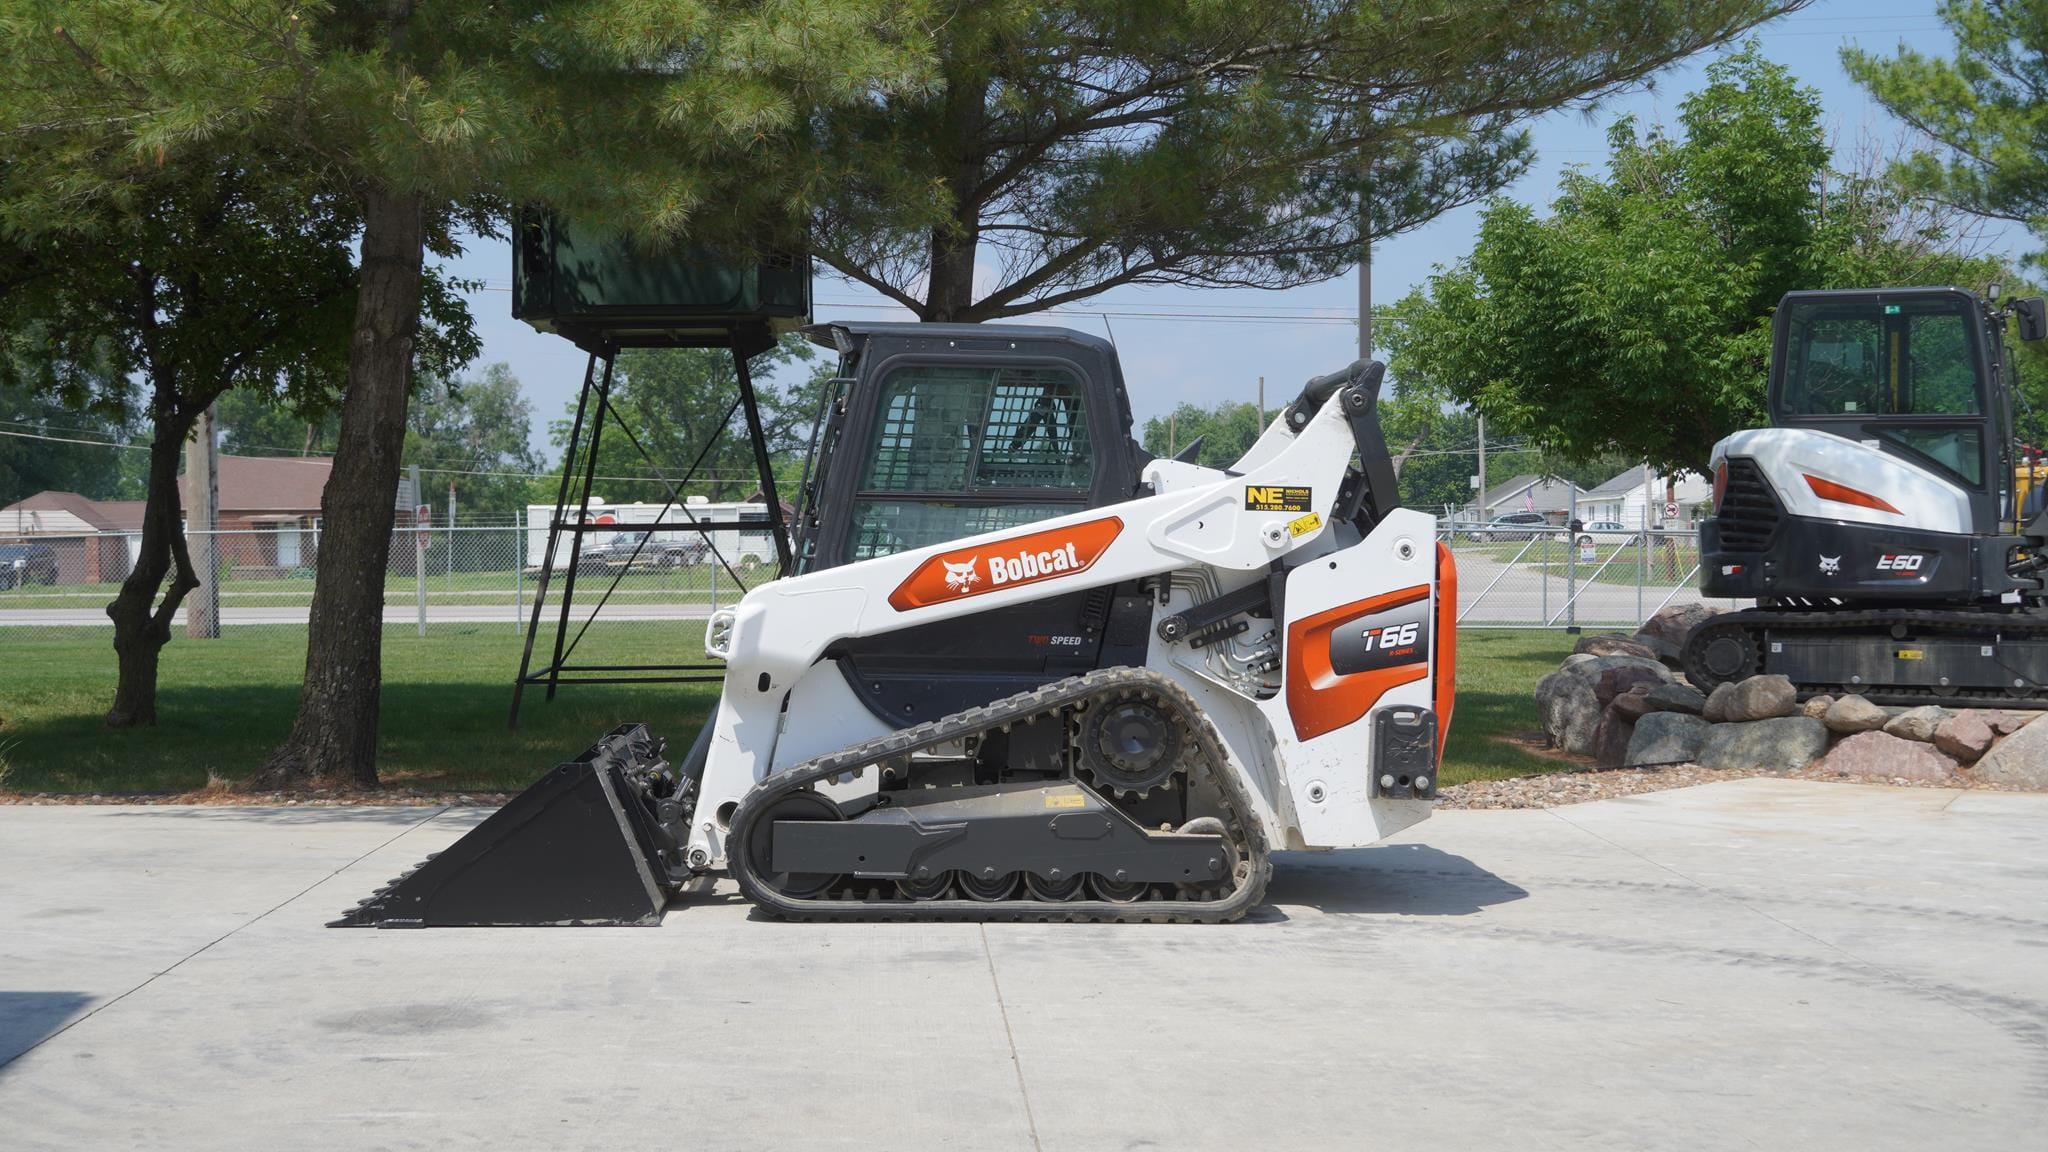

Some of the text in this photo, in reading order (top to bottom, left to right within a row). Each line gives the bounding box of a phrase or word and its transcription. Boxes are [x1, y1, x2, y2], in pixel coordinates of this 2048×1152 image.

[1248, 487, 1284, 503] NE
[988, 542, 1079, 585] Bobcat
[1876, 555, 1923, 570] E60
[1050, 636, 1082, 645] SPEED
[1362, 622, 1419, 652] T66
